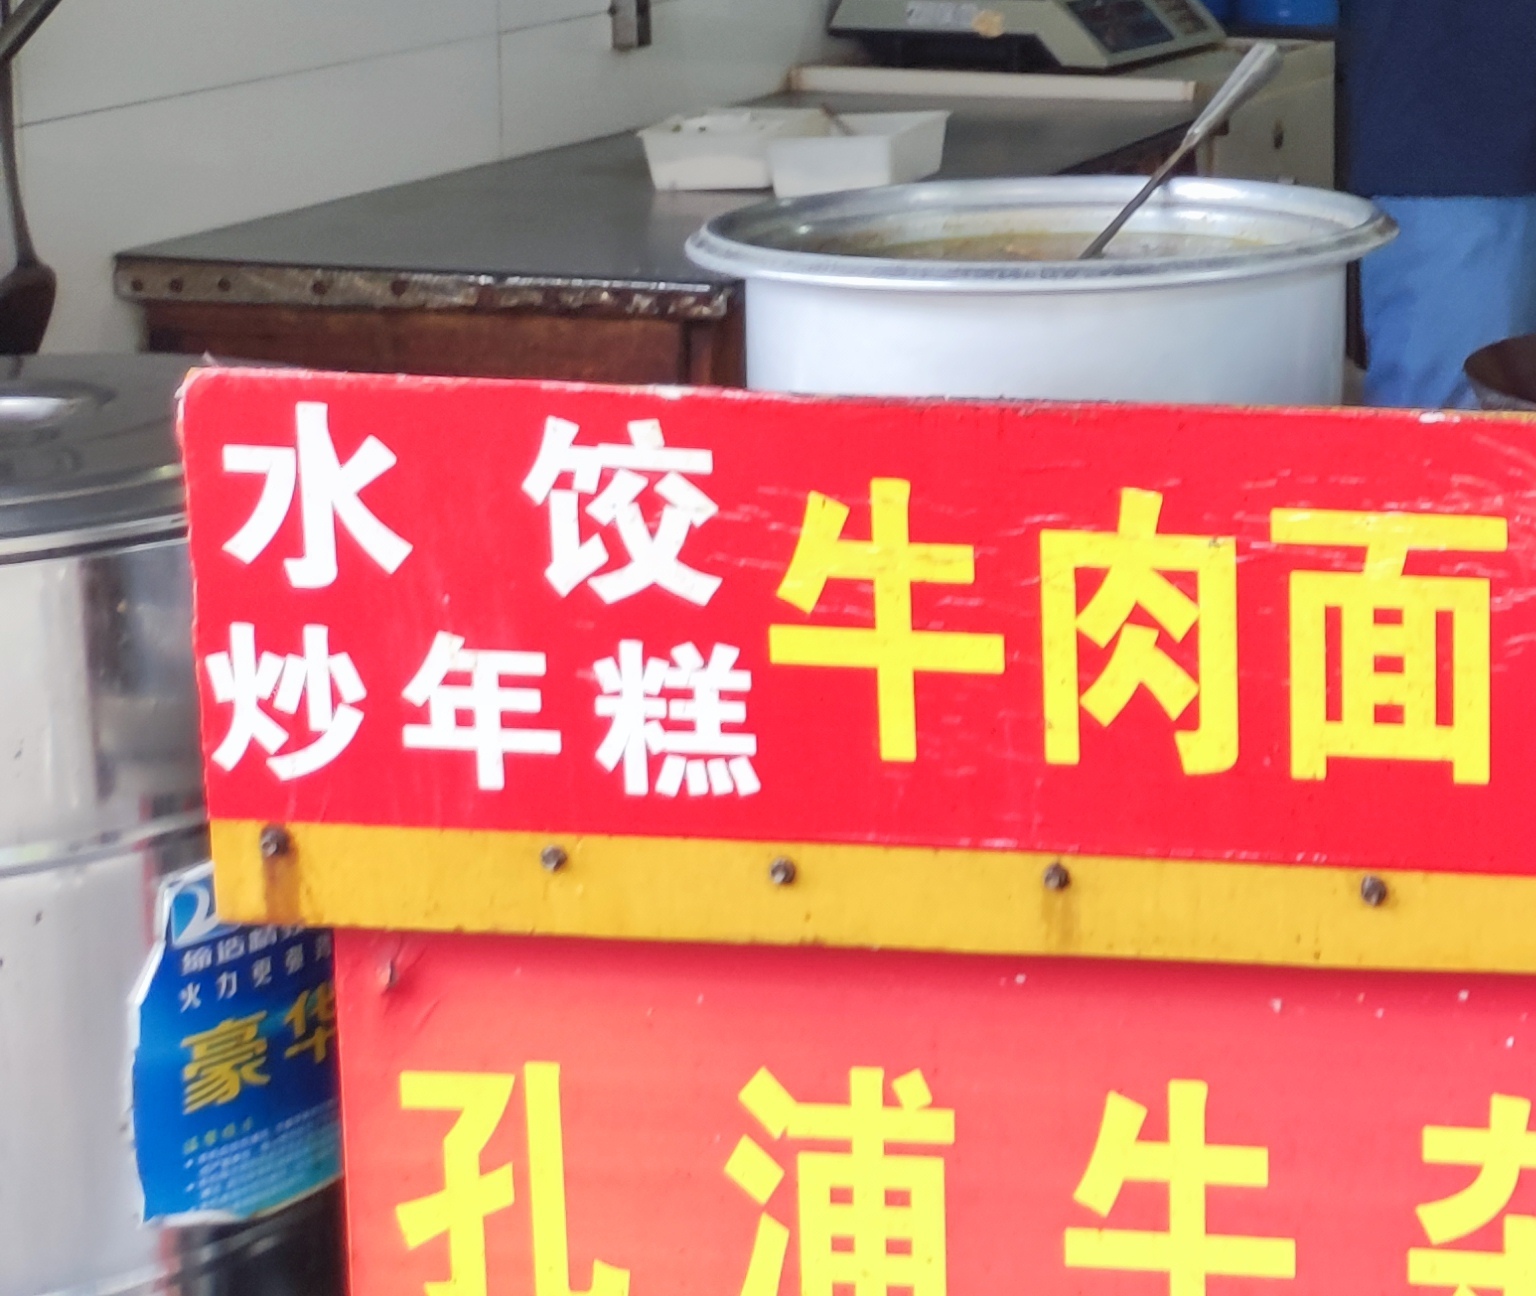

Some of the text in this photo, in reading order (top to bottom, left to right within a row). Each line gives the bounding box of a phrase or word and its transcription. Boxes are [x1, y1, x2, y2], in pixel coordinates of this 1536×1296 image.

[222, 402, 722, 604] 水饺
[208, 623, 762, 798] 炒年糕
[769, 477, 1508, 785] 牛肉面
[181, 982, 336, 1115] 豪华
